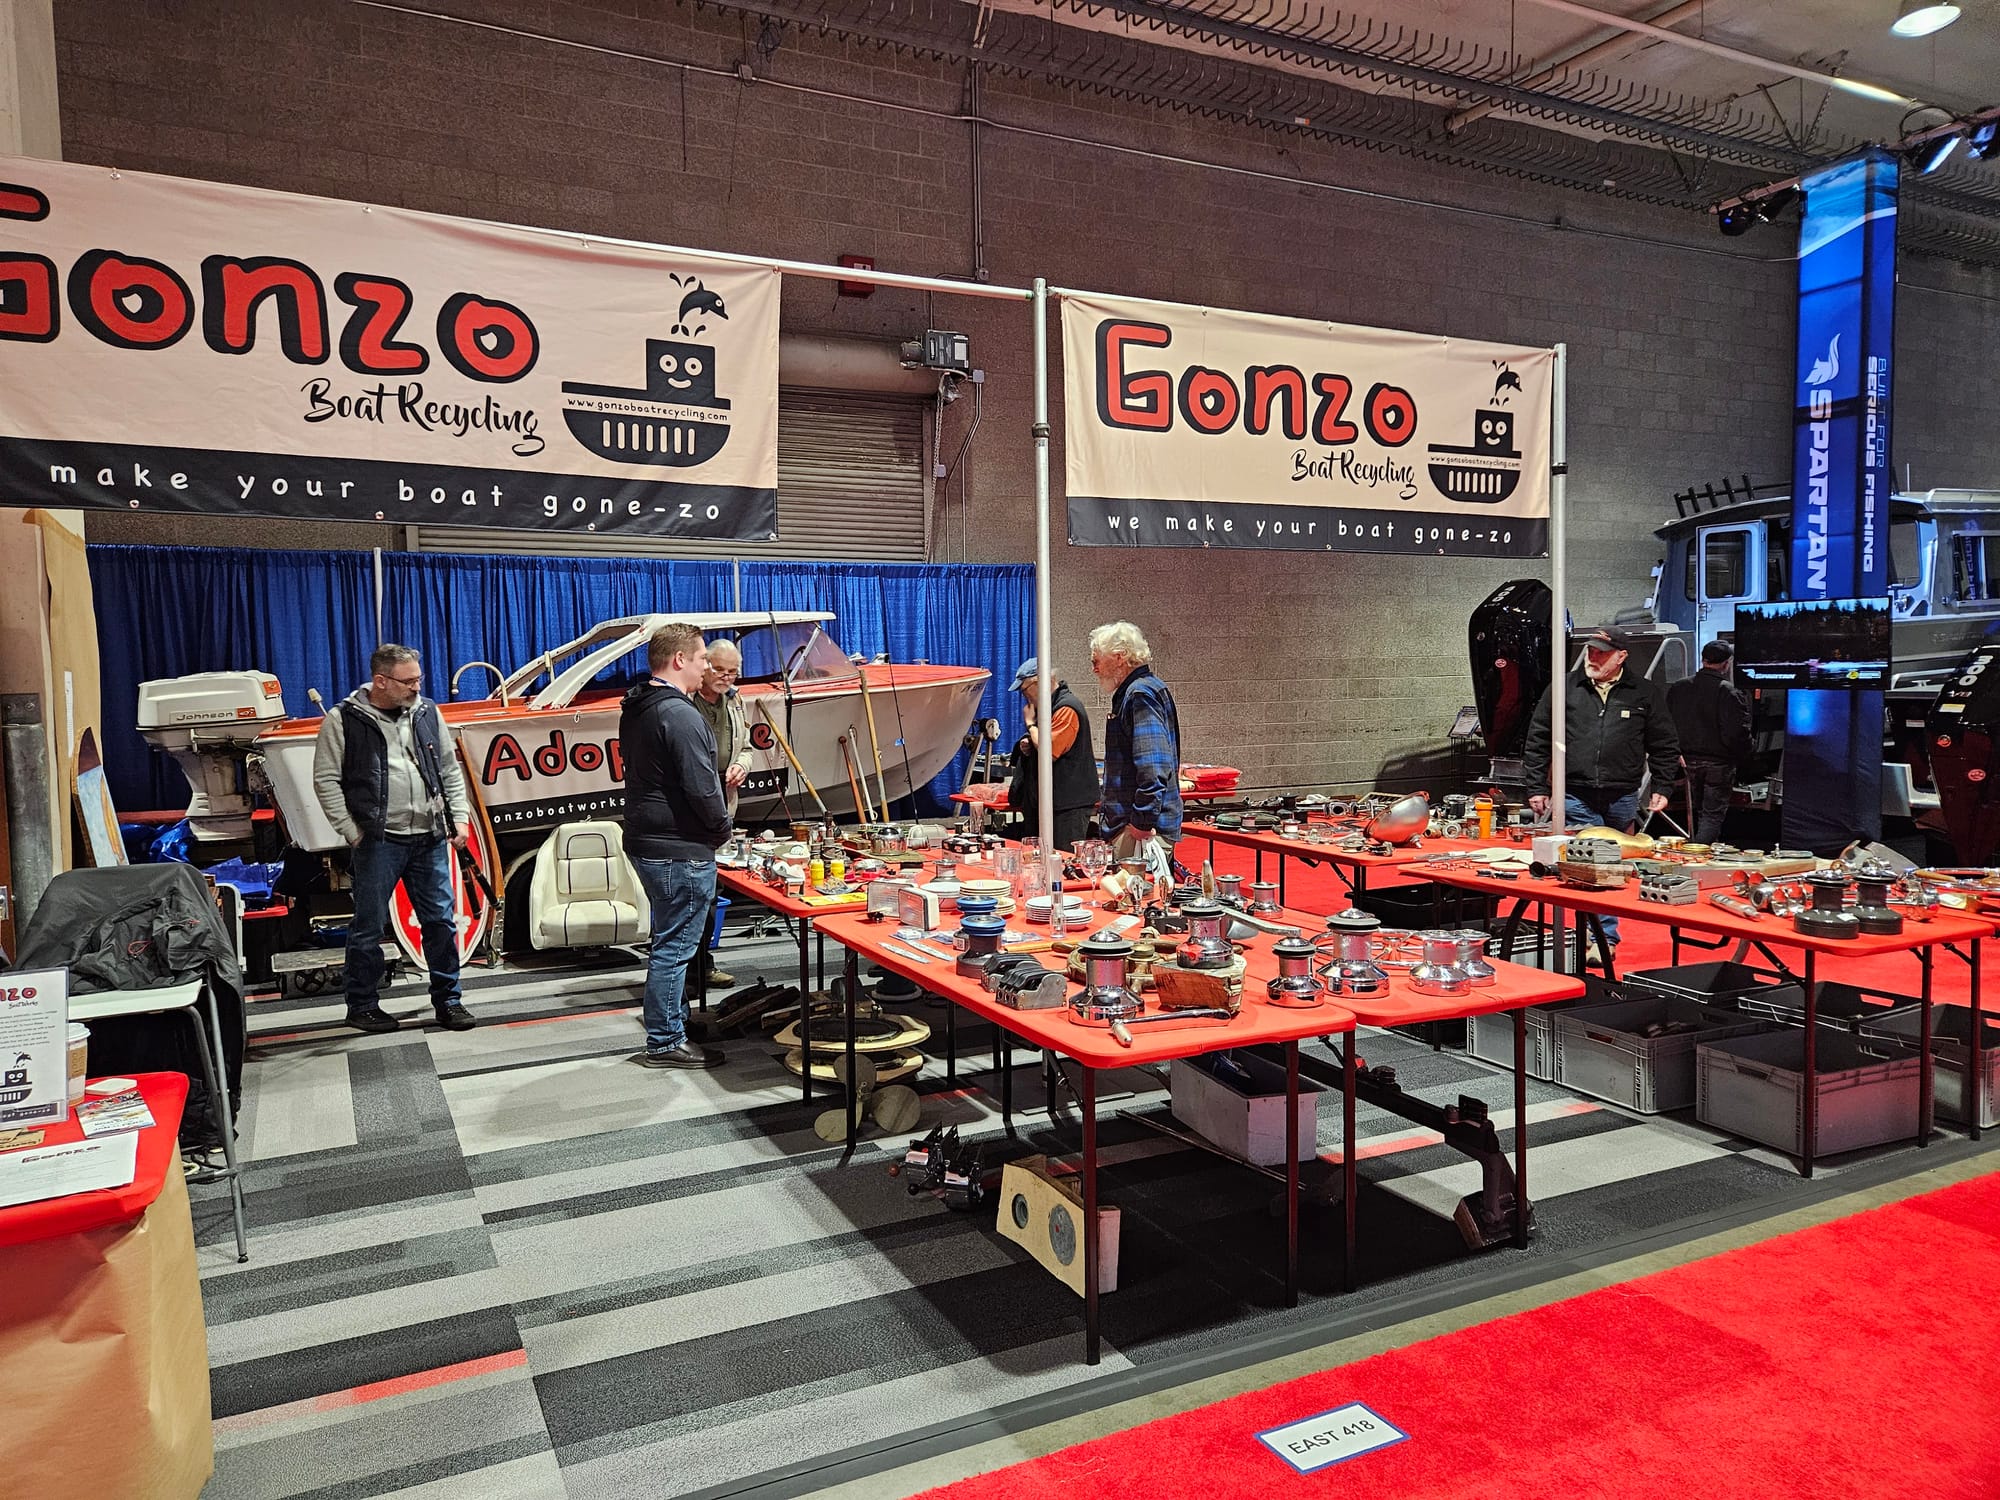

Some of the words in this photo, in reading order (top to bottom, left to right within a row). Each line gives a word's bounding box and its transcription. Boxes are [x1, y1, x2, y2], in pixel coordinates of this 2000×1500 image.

[567, 398, 728, 421] www.gonzoboatrecycling.com
[1095, 318, 1418, 447] Gonzo
[1877, 357, 1887, 414] BUILT
[301, 378, 400, 423] Boat
[398, 382, 546, 457] Recycling
[1865, 355, 1879, 467] SERIOUS
[1875, 420, 1886, 468] FOR
[50, 461, 189, 491] make
[237, 470, 355, 499] your
[398, 478, 504, 507] boat
[542, 492, 721, 520] gone-zo
[1290, 448, 1342, 481] Boat
[1341, 449, 1418, 500] Recycling
[1806, 388, 1833, 591] SPARTAN
[1108, 515, 1140, 528] we
[1166, 513, 1235, 532] make
[1256, 518, 1317, 537] your
[1338, 519, 1395, 538] boat
[1414, 526, 1512, 544] gone-zo
[1862, 473, 1876, 573] FISHING
[177, 711, 233, 721] Johnson
[493, 796, 626, 824] onzoboatworks
[1288, 1430, 1340, 1454] EAST
[1343, 1420, 1375, 1436] 418
